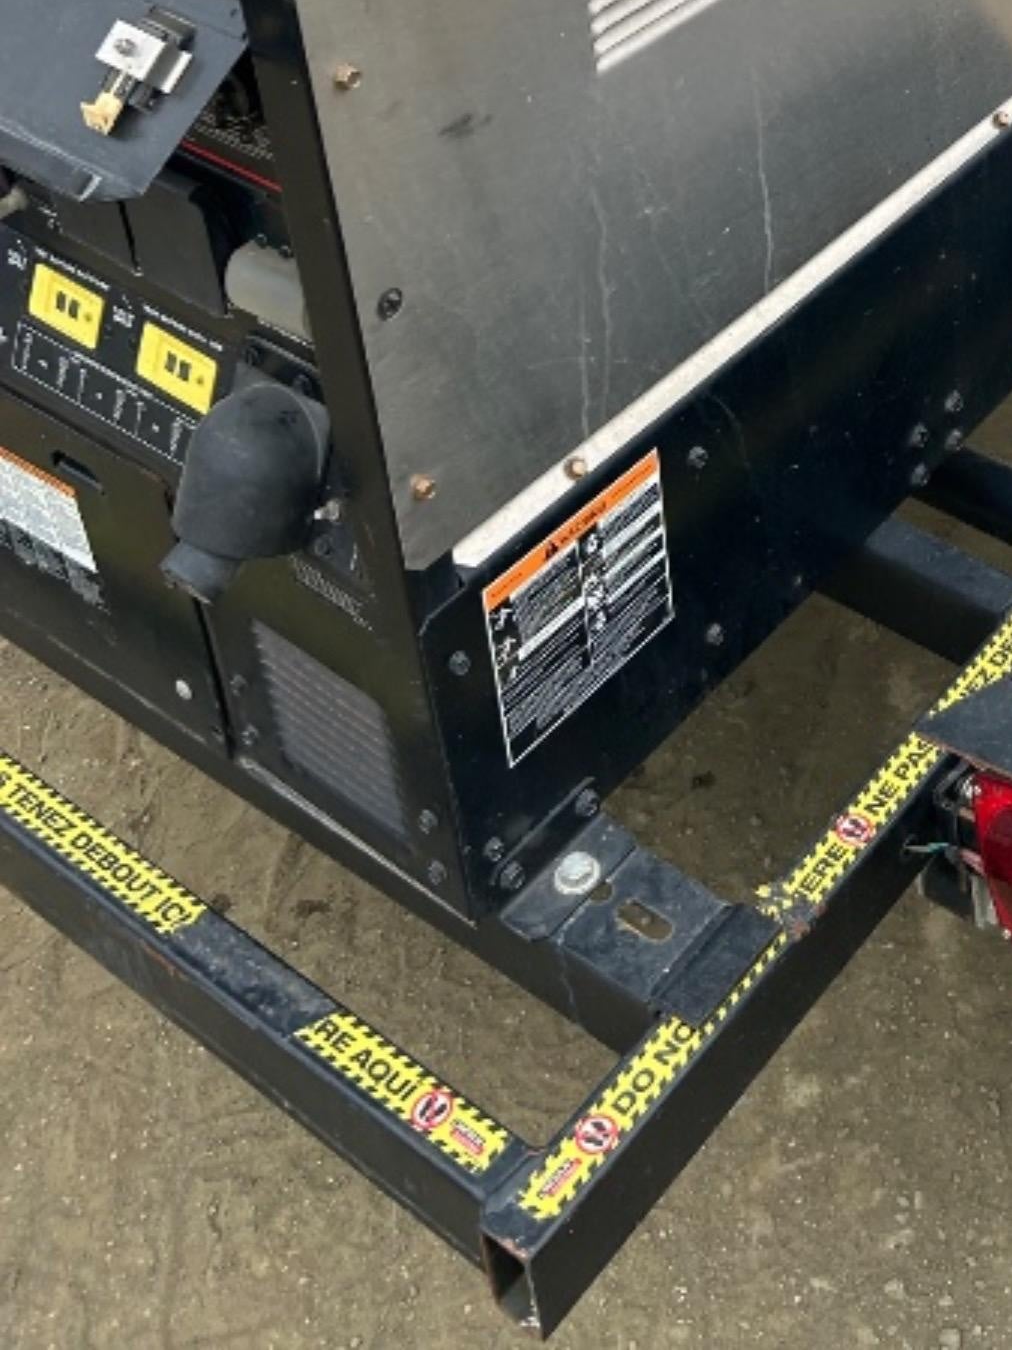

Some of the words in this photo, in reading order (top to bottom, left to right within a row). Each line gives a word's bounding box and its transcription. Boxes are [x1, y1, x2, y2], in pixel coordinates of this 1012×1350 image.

[864, 782, 900, 817] NE
[8, 782, 78, 838] TENEZ
[70, 831, 164, 902] DEBOUT
[799, 843, 847, 892] ERE
[612, 1067, 656, 1116] DO
